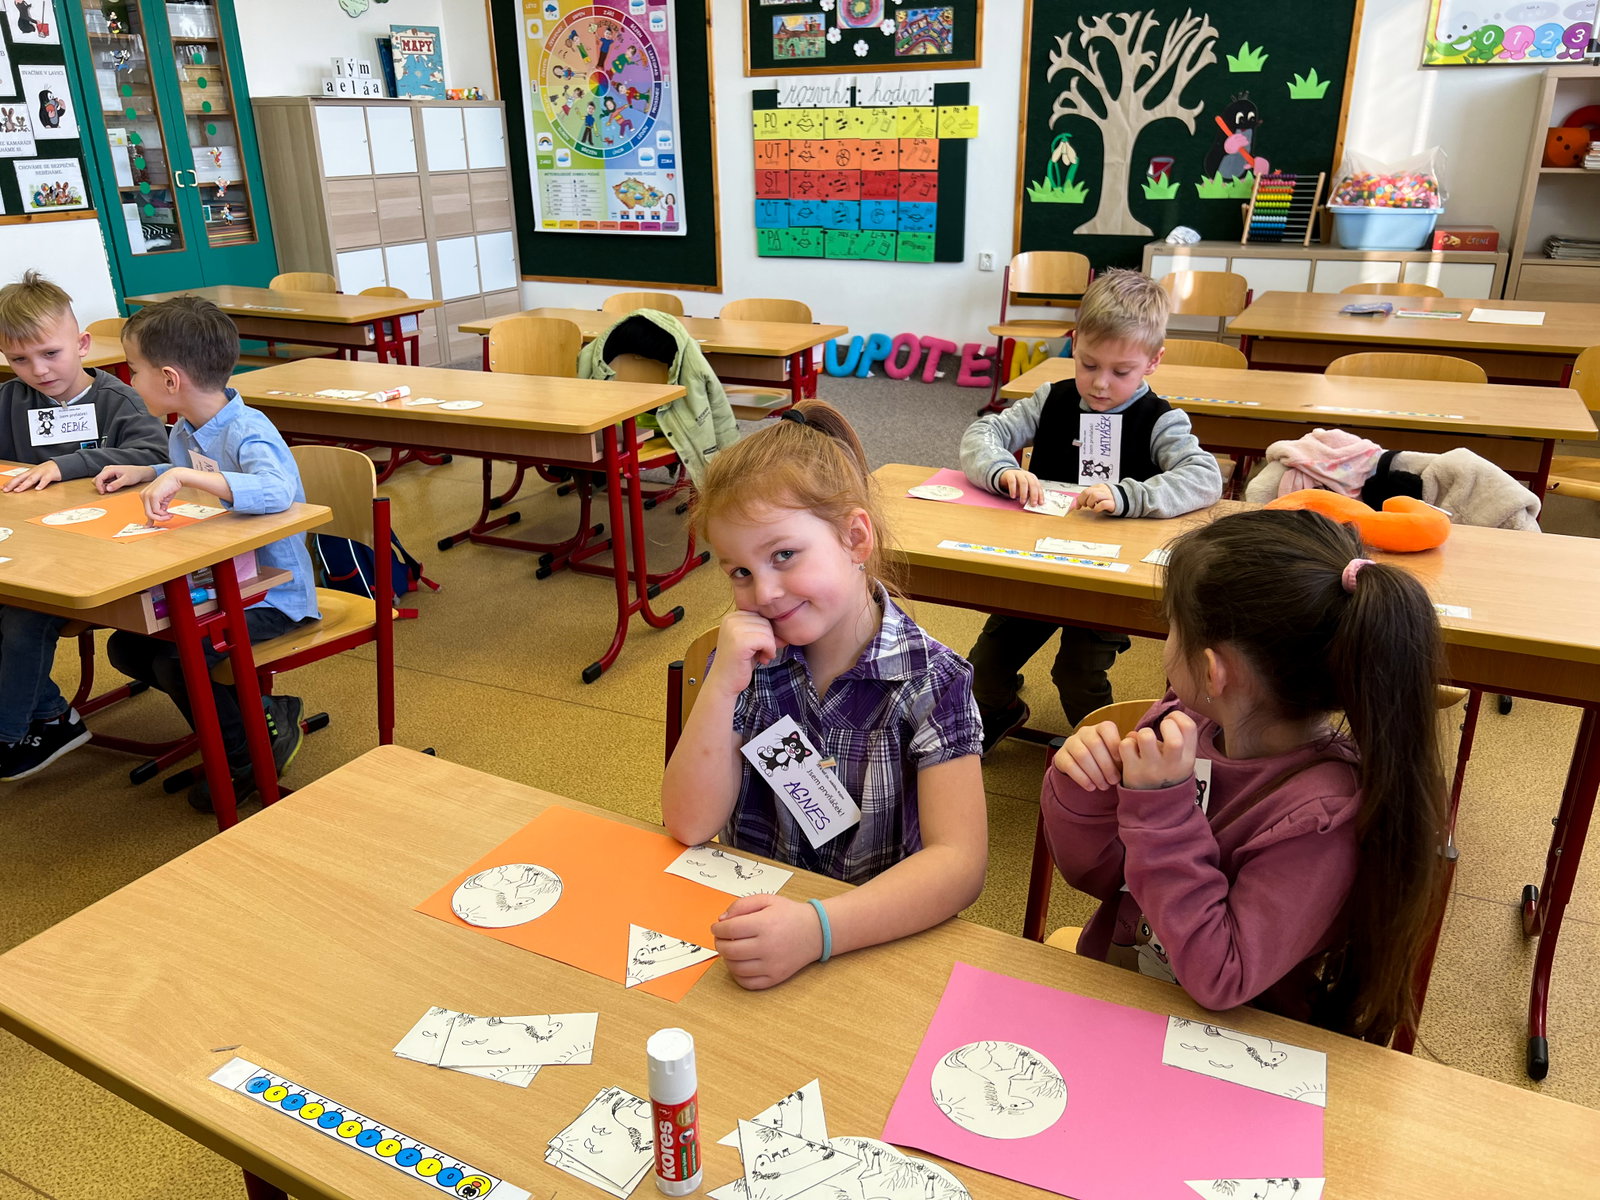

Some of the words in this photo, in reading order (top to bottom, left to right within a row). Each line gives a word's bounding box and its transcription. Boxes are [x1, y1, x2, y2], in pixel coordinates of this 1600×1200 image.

[401, 39, 432, 52] MAPY
[1483, 30, 1495, 45] 0
[1513, 31, 1520, 45] 1
[1541, 30, 1554, 45] 2
[1571, 29, 1586, 43] 3
[648, 50, 658, 76] LISTOPAD
[783, 77, 847, 104] rozvrh
[867, 76, 927, 103] hodin
[763, 112, 778, 128] PO
[765, 142, 782, 158] ÚT
[765, 171, 780, 191] ST
[60, 416, 89, 433] SEBÍK
[1094, 415, 1111, 457] MATYÁŠEK
[806, 769, 821, 786] Jsem
[818, 785, 845, 817] prvňáček!
[783, 781, 831, 831] AGNES
